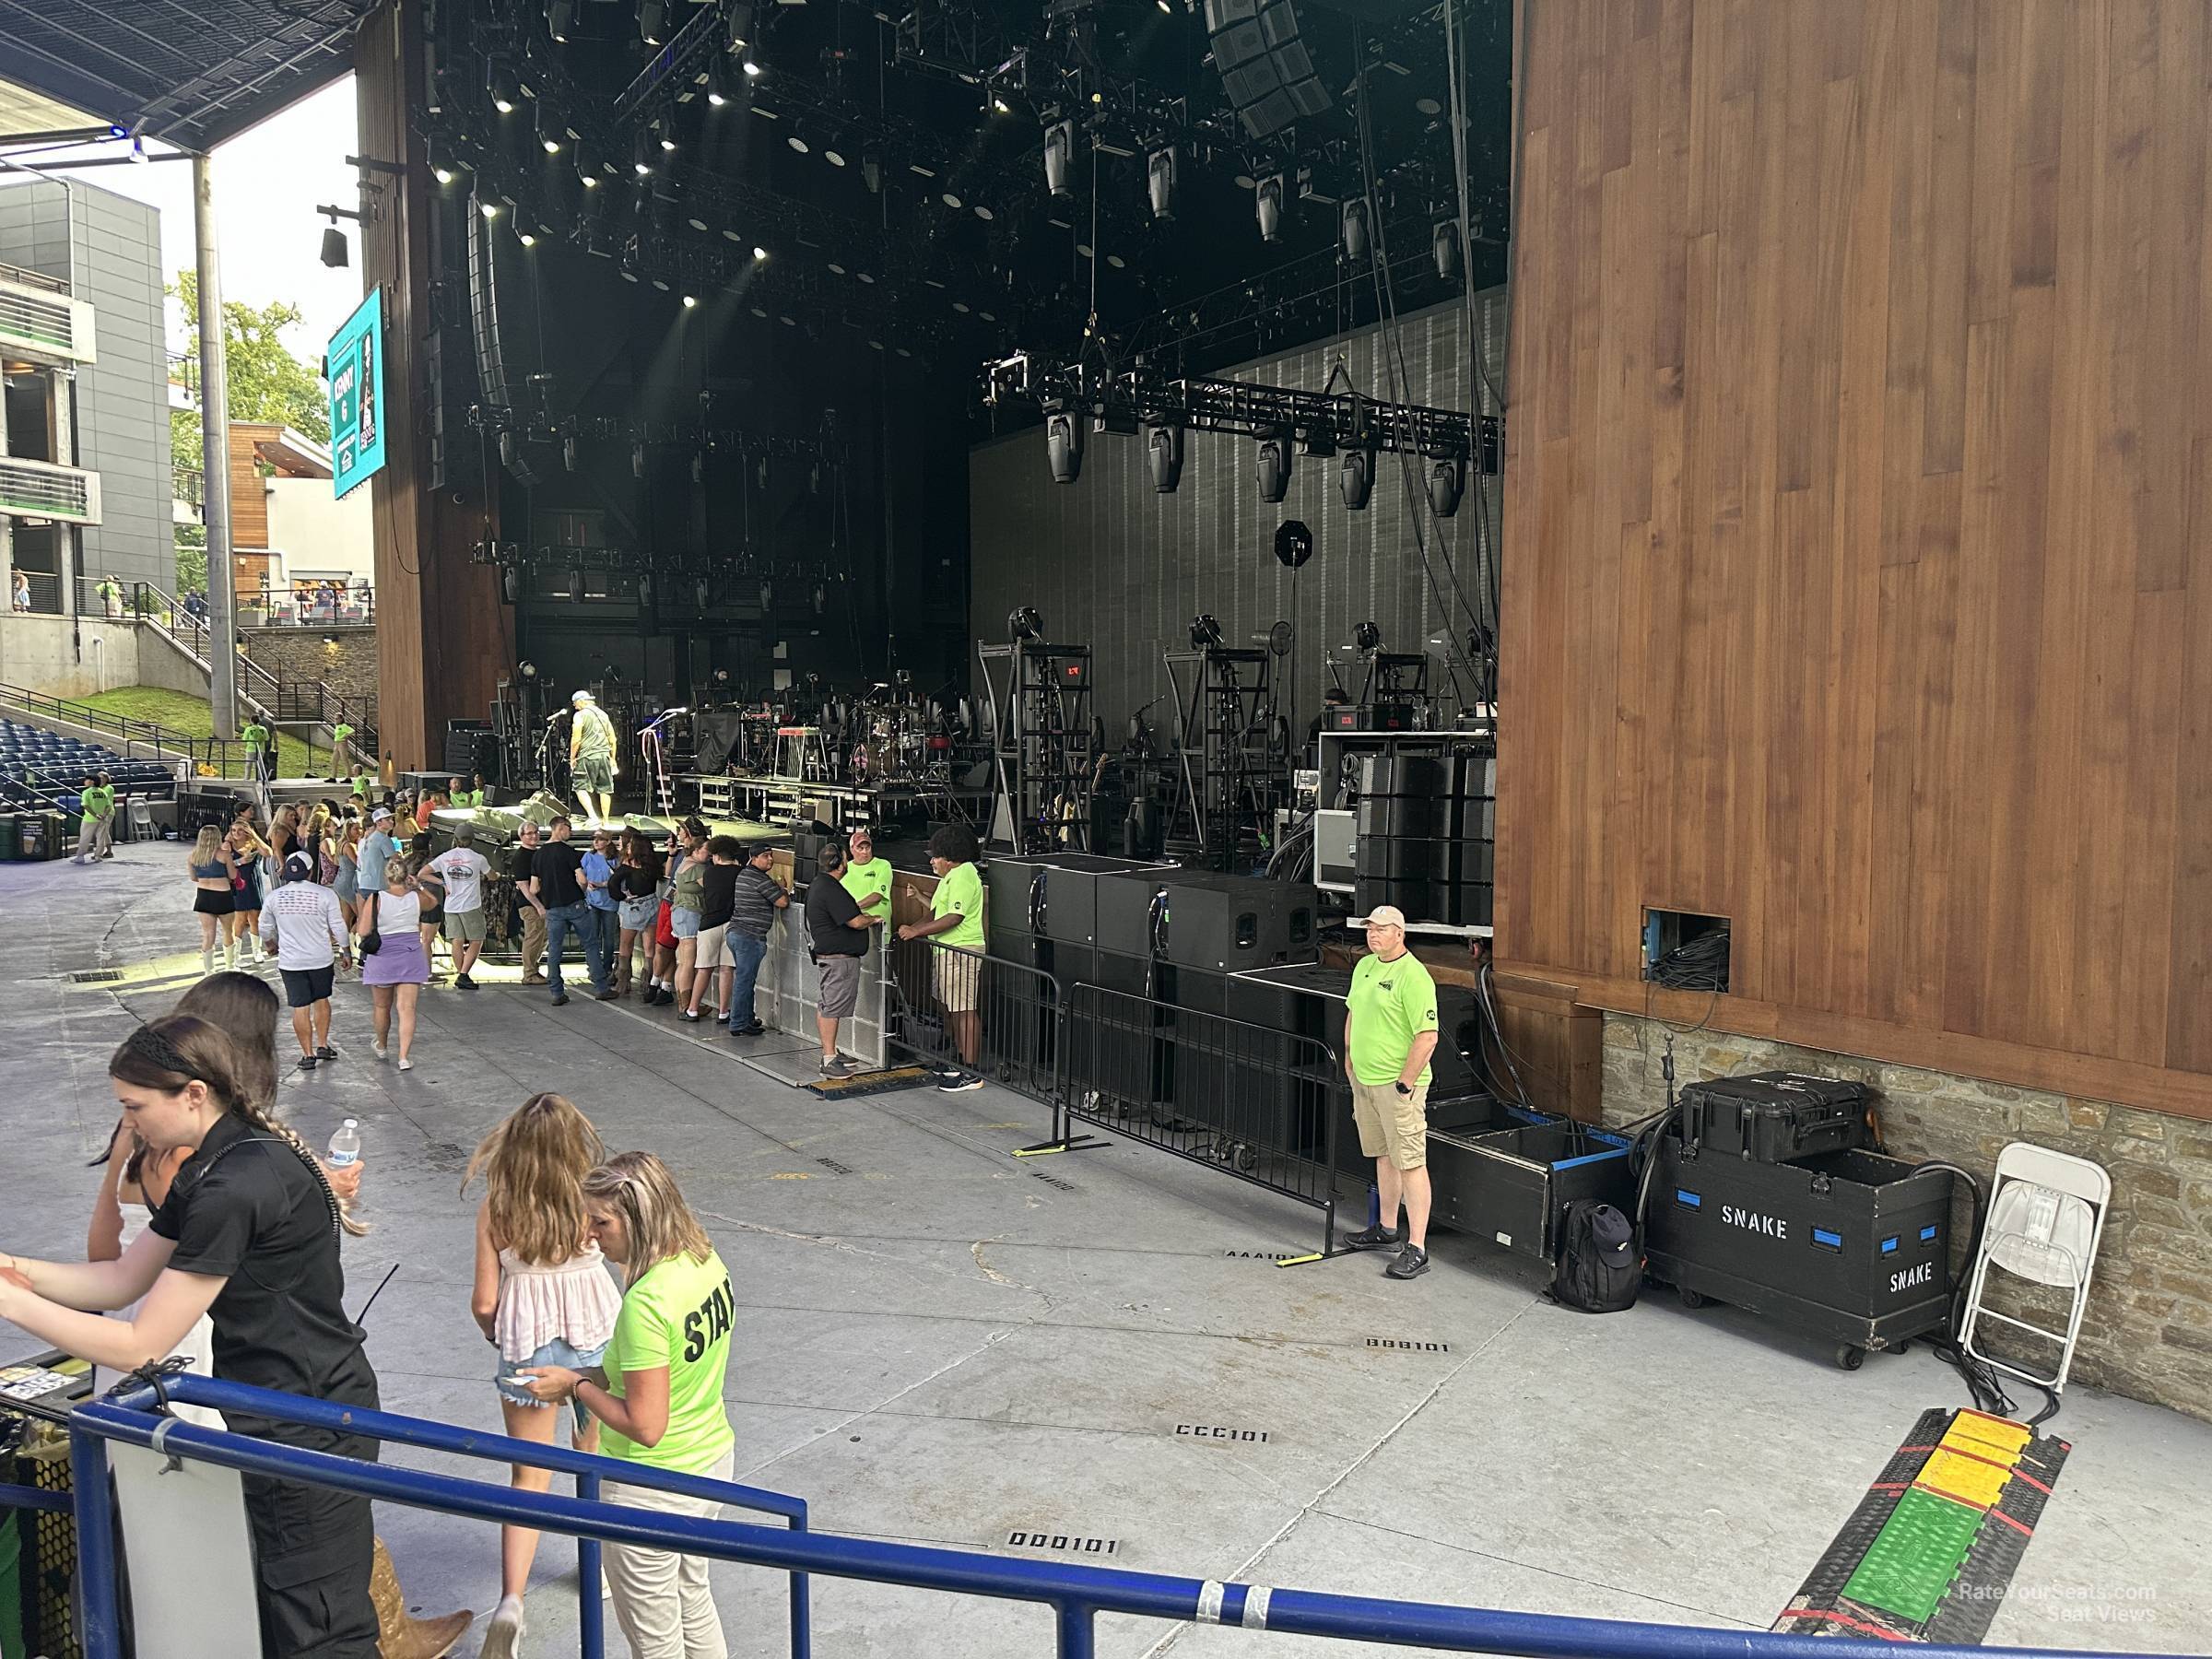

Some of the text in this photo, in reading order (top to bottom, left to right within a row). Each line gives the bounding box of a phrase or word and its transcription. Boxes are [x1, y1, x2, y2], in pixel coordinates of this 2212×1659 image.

[334, 364, 354, 403] KENNY
[1722, 1205, 1787, 1240] SNAKE
[1889, 1261, 1932, 1293] SNAKE
[1366, 1338, 1449, 1352] BBB101
[1175, 1424, 1267, 1442] CCC101
[1008, 1532, 1116, 1554] DDD101
